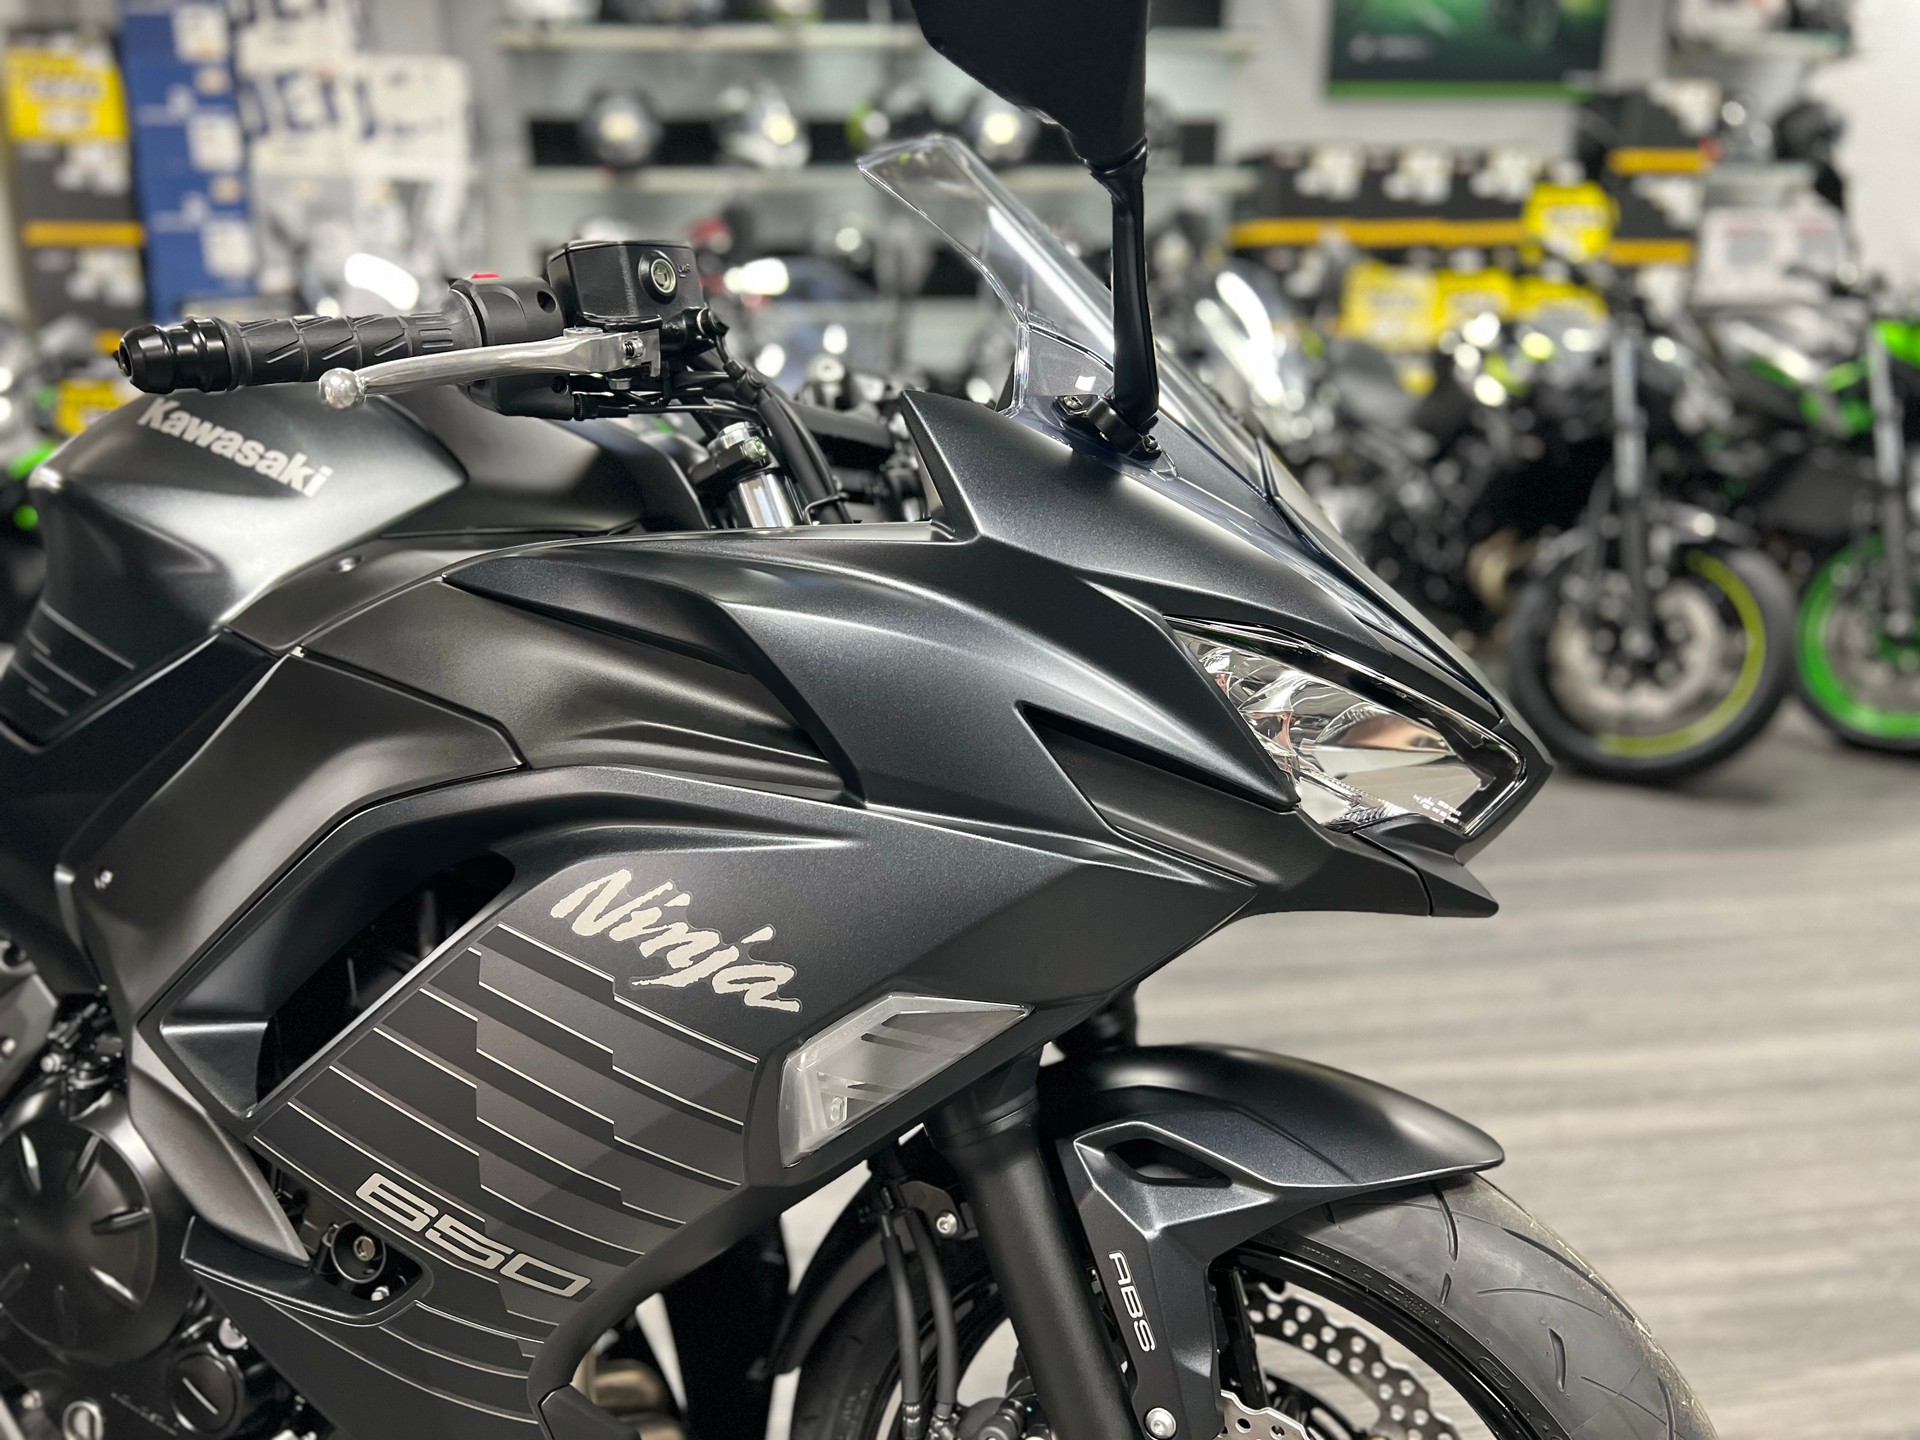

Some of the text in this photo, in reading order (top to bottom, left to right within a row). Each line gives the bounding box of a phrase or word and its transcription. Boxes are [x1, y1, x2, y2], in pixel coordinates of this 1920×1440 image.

[137, 397, 334, 498] Kawasaki
[550, 868, 800, 1012] Ninja
[355, 1172, 592, 1298] 650
[1108, 1252, 1156, 1352] ABS
